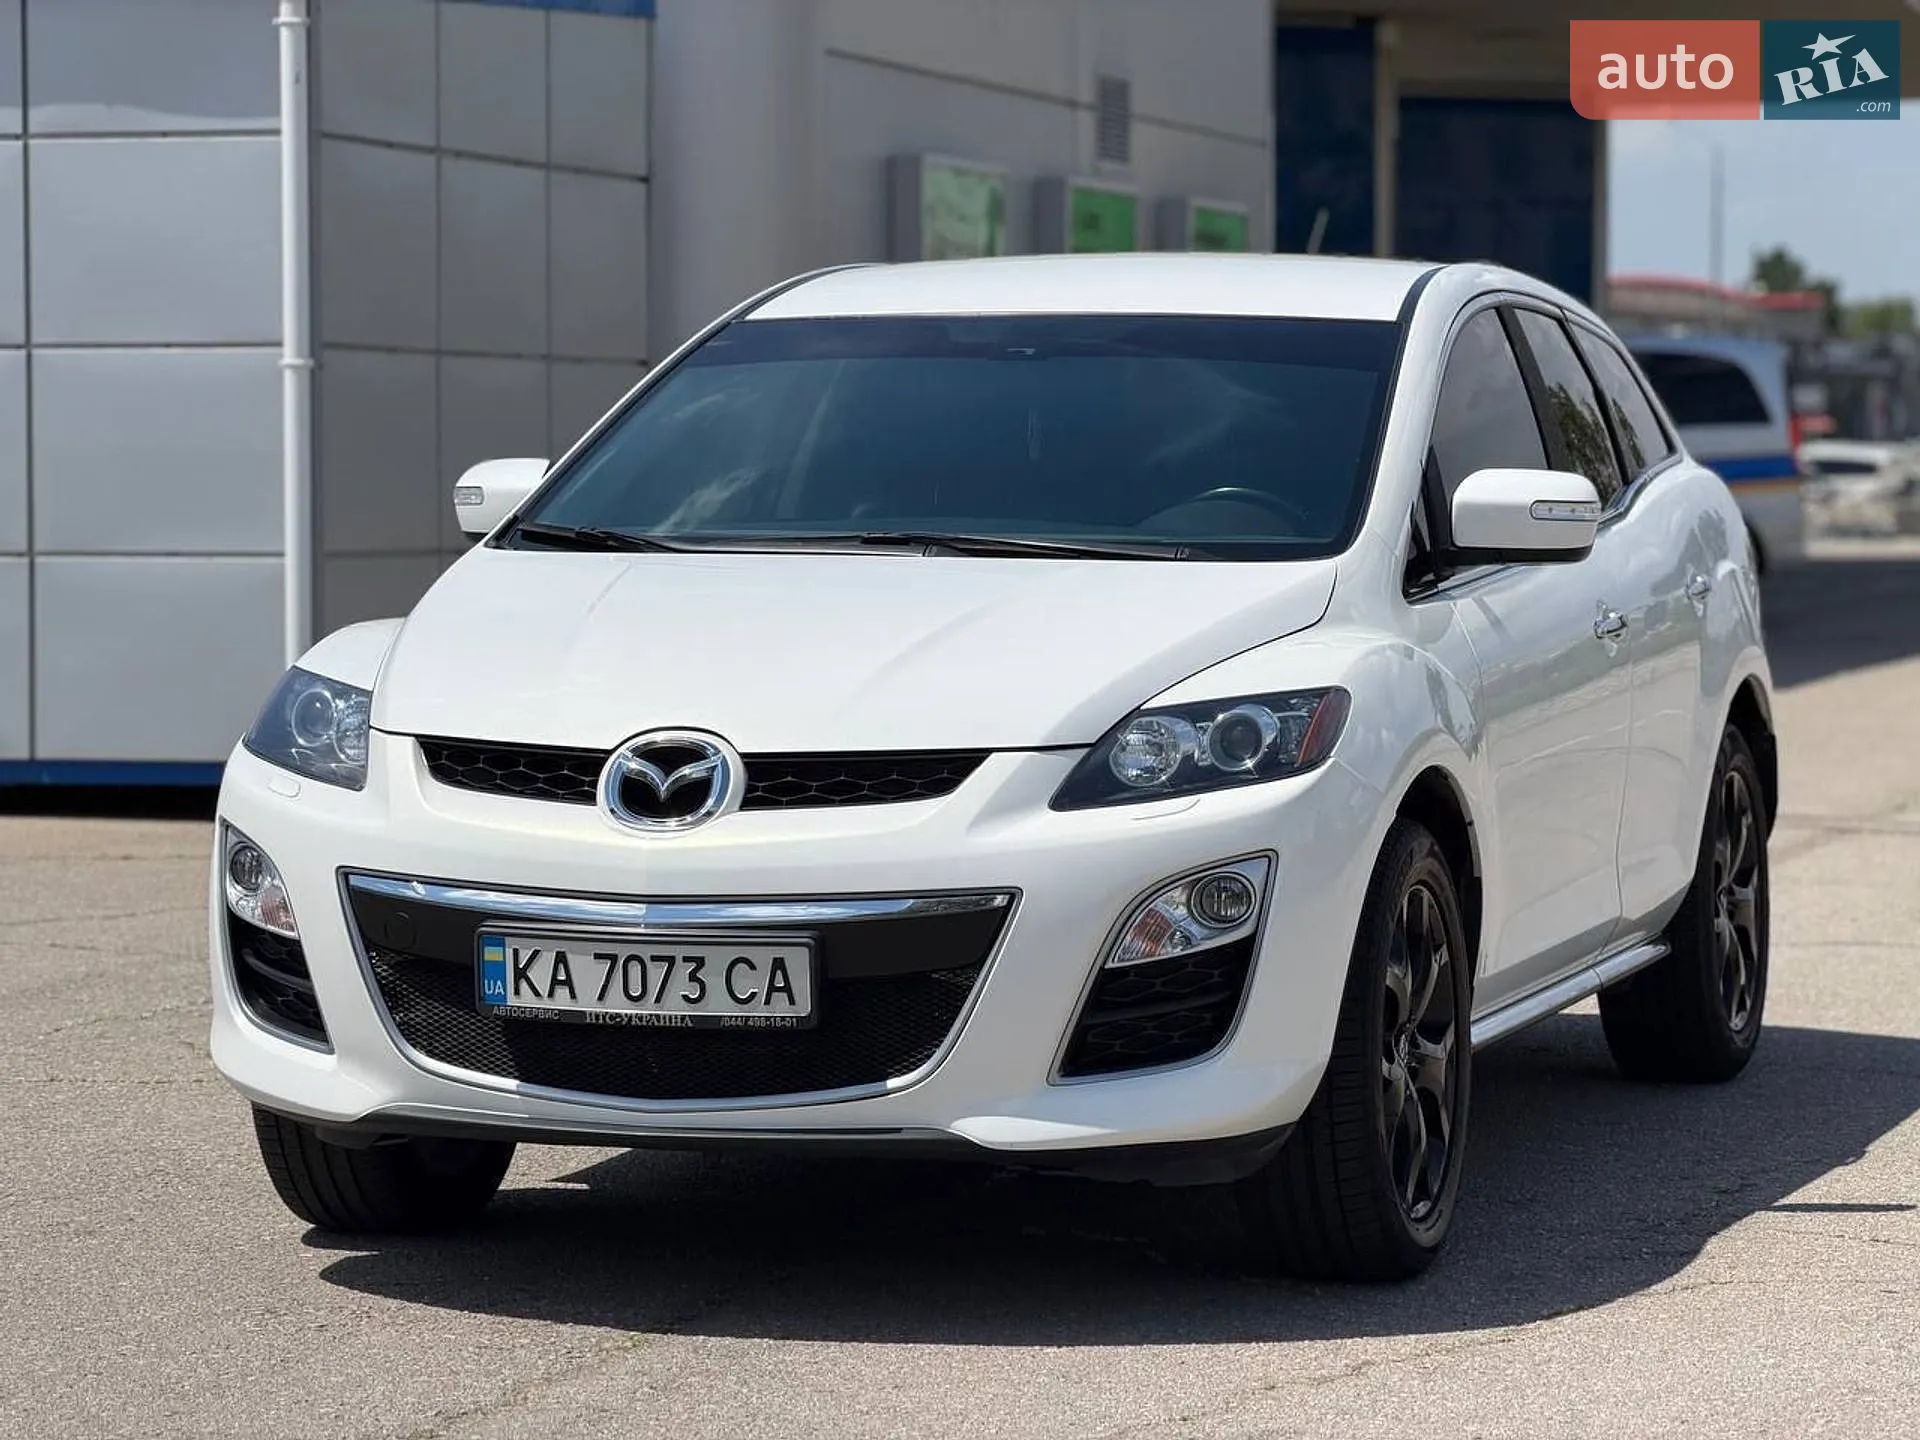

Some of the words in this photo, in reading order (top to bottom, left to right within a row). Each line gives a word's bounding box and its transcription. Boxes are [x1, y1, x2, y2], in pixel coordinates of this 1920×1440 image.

[512, 947, 577, 1000] KA
[593, 952, 707, 1004] 7073
[725, 956, 796, 1006] CA
[484, 979, 505, 996] UA
[492, 1006, 560, 1020] АВТОСЕРВИС
